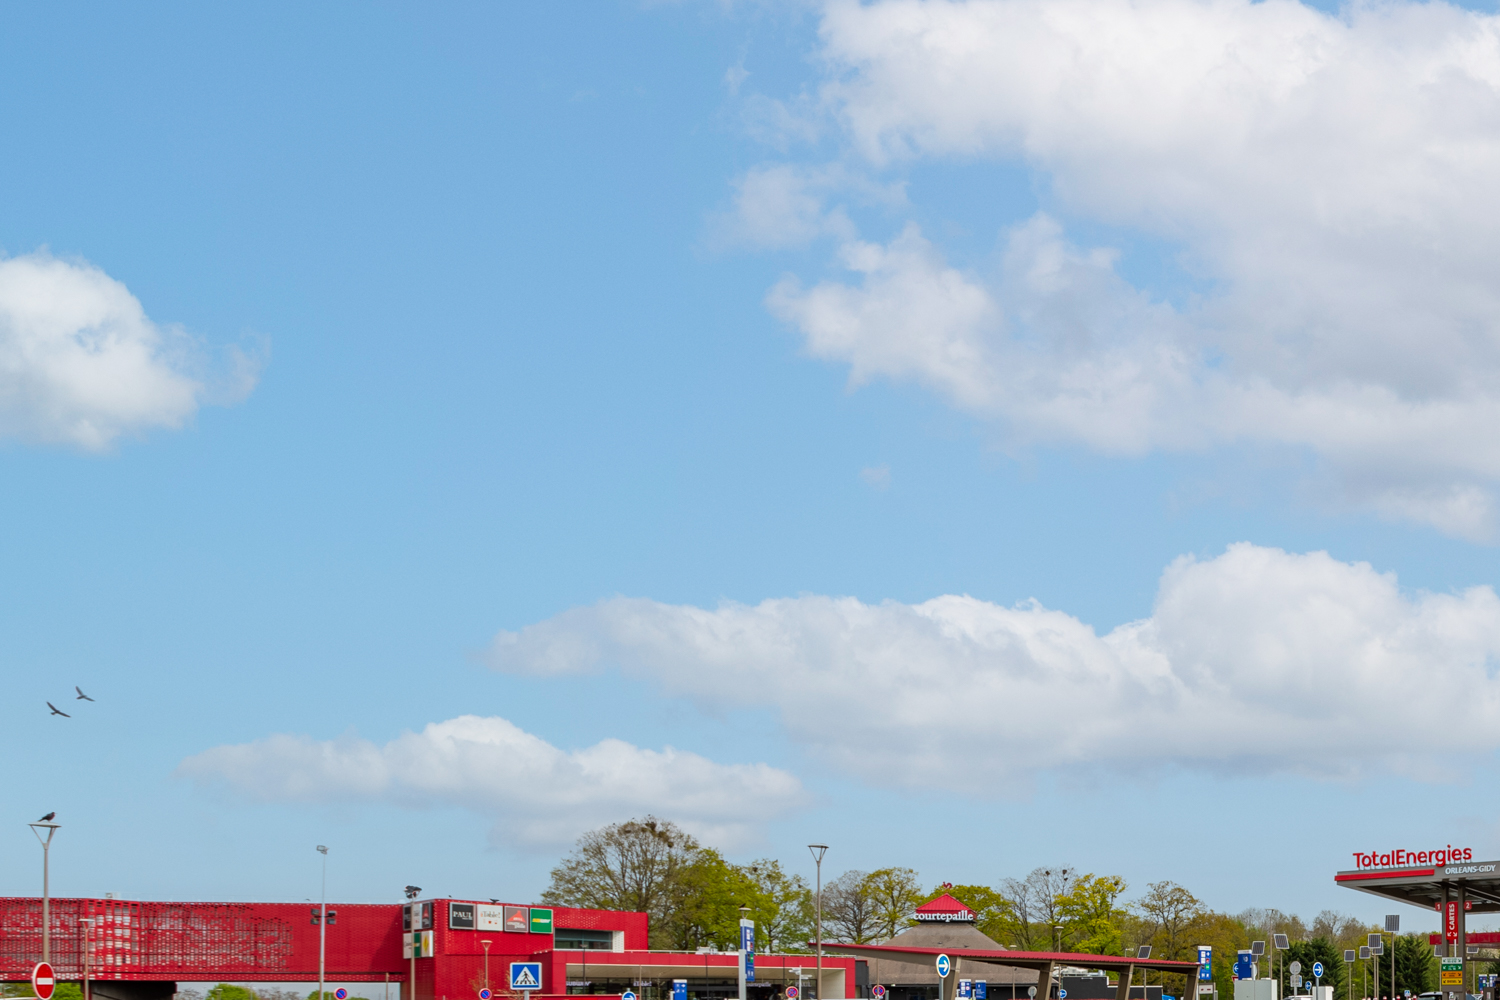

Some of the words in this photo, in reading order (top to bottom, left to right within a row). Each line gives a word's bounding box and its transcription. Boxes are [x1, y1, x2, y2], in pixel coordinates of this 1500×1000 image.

[1353, 844, 1472, 868] TotalEnergies
[1445, 864, 1496, 875] ORLEANS-GIDY
[453, 910, 473, 918] PAUL
[913, 910, 973, 922] courtepaille
